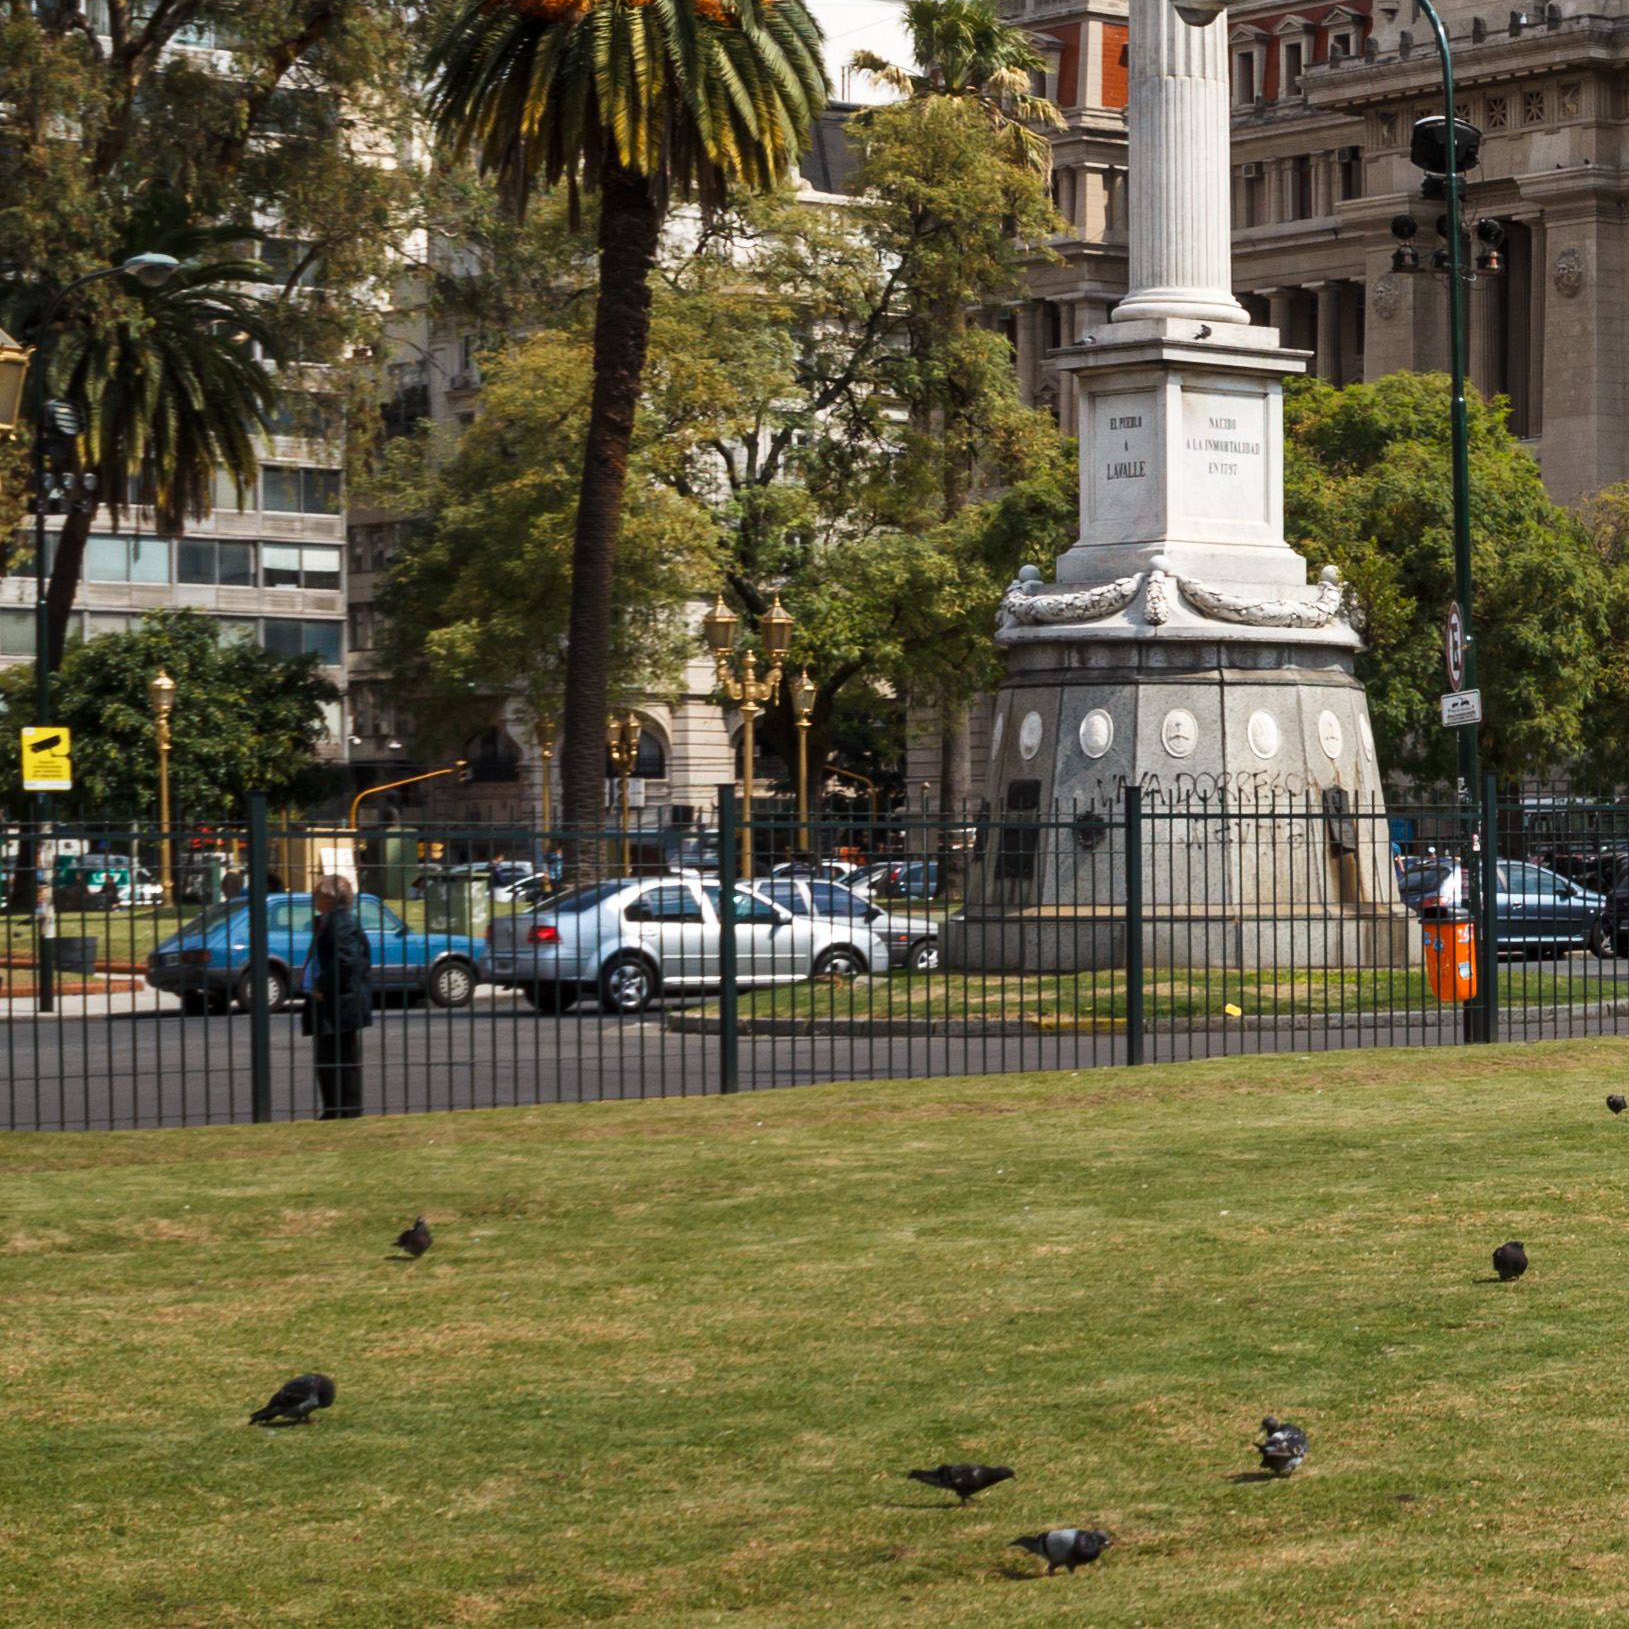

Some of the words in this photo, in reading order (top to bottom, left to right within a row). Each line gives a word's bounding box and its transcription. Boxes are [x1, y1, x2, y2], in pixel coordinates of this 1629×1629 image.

[1209, 417, 1236, 430] NACIDO
[1193, 438, 1203, 451] LA
[1205, 439, 1260, 455] INMORTALIDAD
[1107, 461, 1145, 480] LAVALLE
